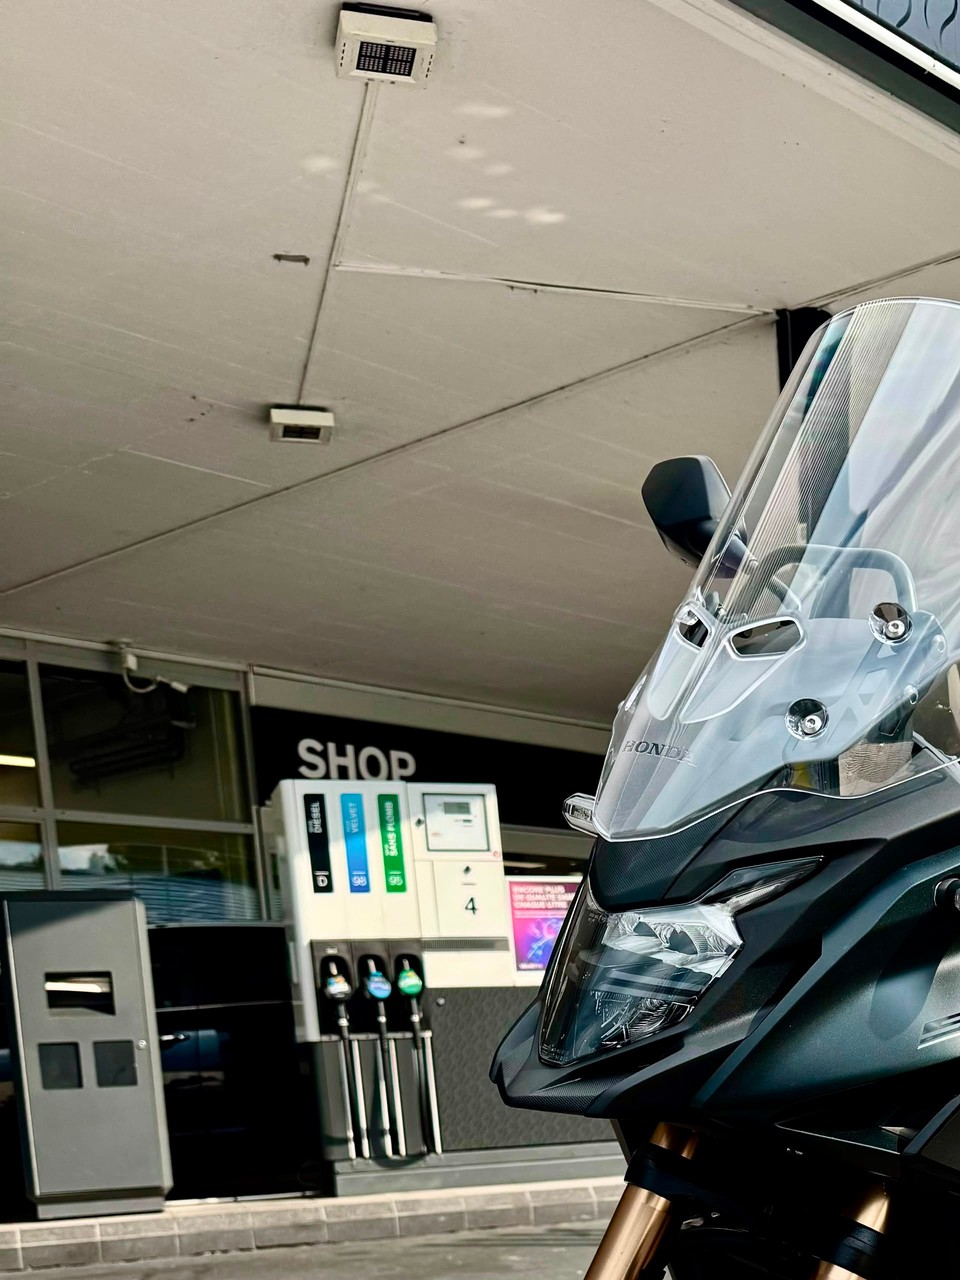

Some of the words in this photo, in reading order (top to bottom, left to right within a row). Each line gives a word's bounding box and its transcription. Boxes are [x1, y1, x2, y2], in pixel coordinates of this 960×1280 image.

[297, 738, 416, 781] SHOP
[622, 740, 695, 765] HONDA
[310, 801, 323, 833] DIESEL
[348, 802, 359, 833] VELVET
[384, 802, 395, 831] PLOMB
[387, 833, 398, 856] SANS
[352, 875, 367, 887] 98
[464, 897, 478, 915] 4
